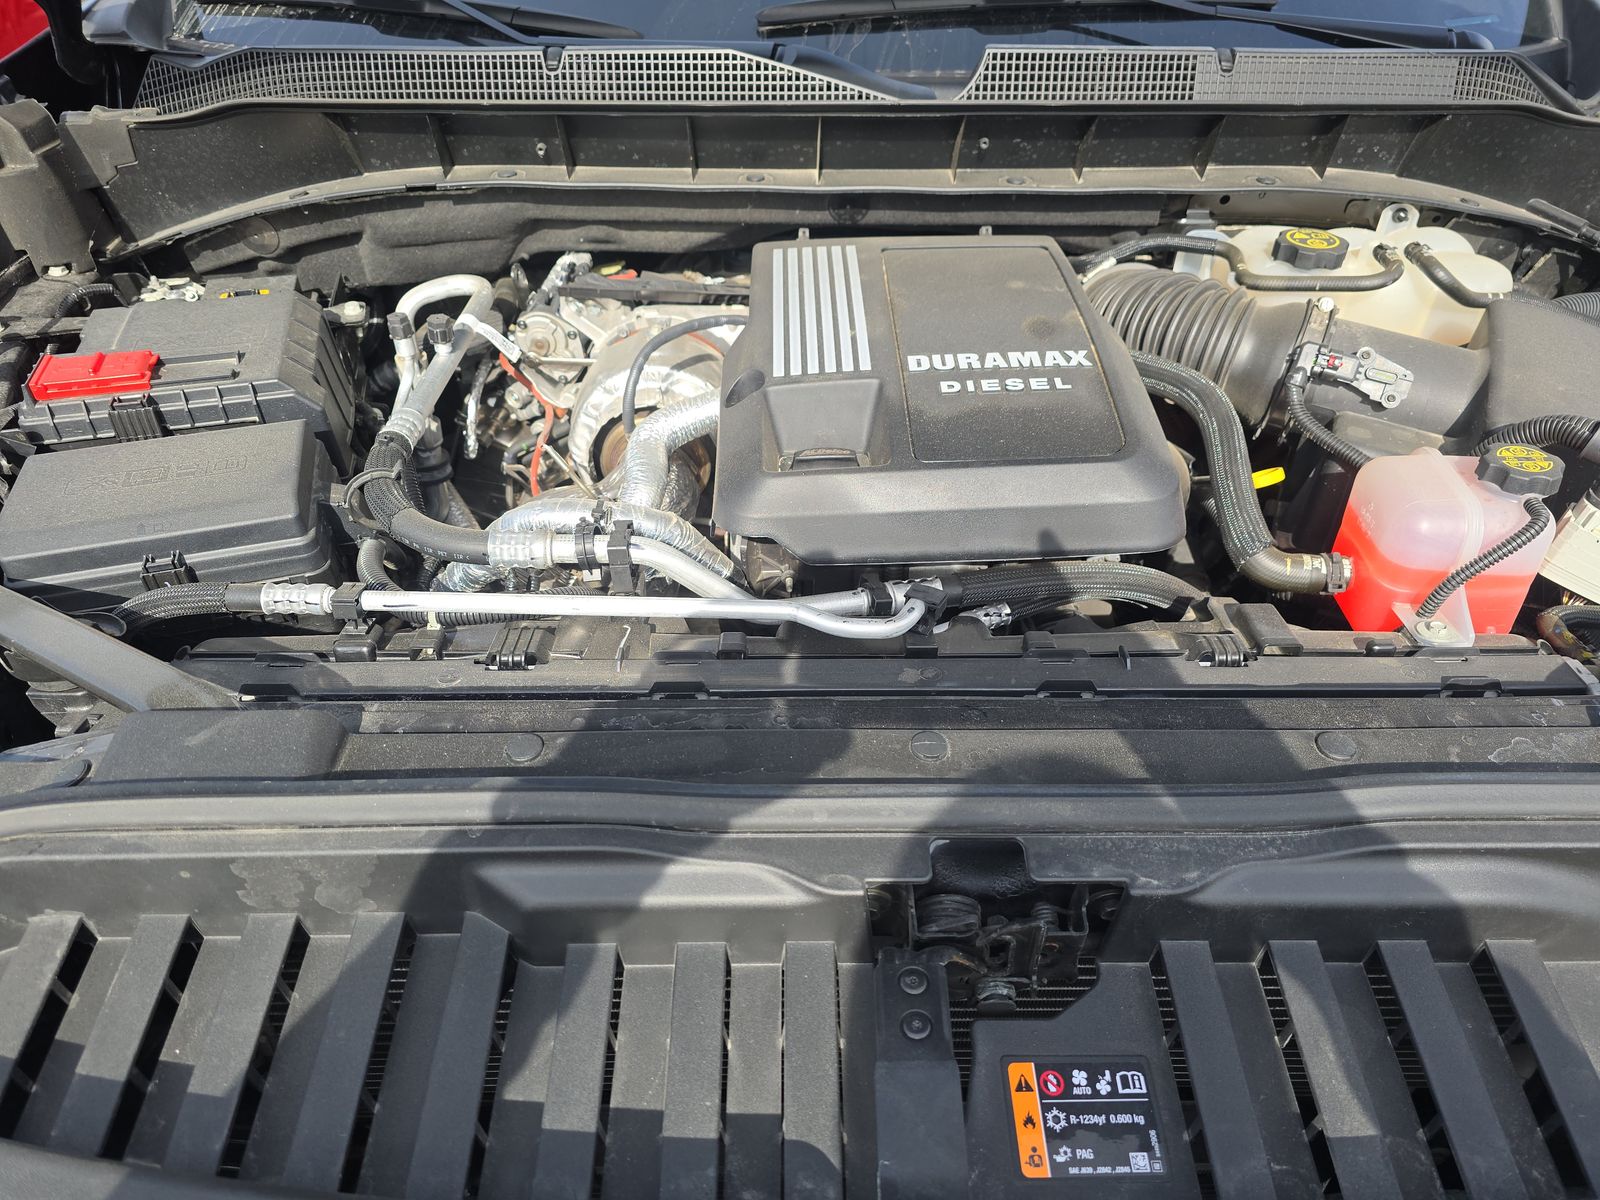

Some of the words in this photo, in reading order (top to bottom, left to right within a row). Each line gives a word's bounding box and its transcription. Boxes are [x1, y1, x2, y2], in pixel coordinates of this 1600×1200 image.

[906, 350, 1093, 372] DURAMAX
[939, 377, 1073, 394] DIESEL
[1072, 1086, 1092, 1095] AUTO
[1069, 1113, 1107, 1126] R-1234yf
[1109, 1113, 1133, 1124] 0.600
[1134, 1113, 1145, 1126] kg
[1076, 1149, 1095, 1160] PAG
